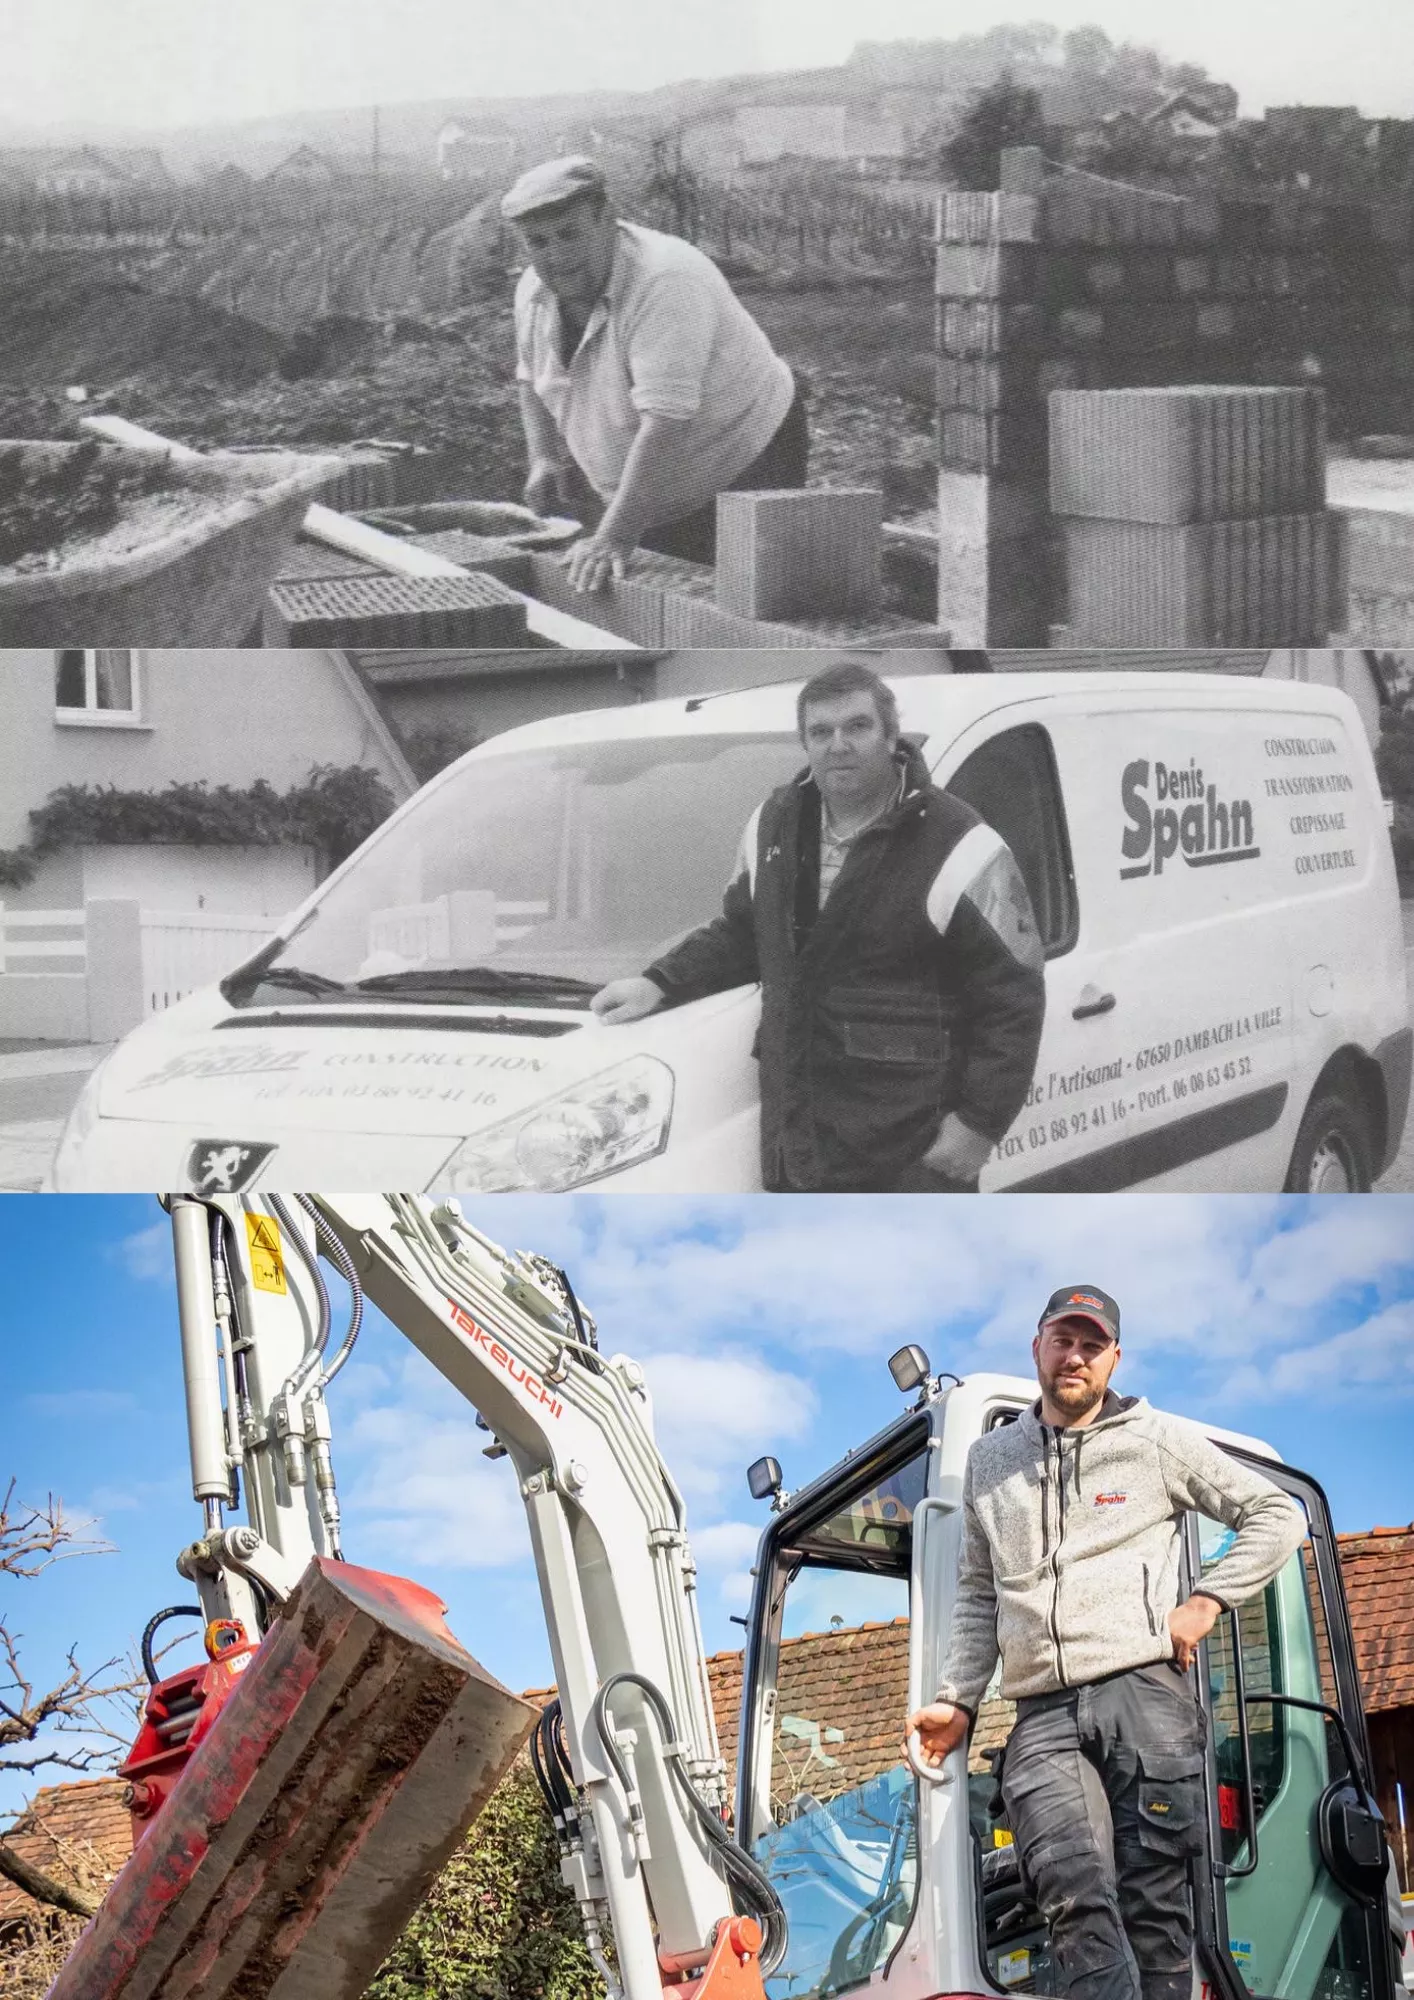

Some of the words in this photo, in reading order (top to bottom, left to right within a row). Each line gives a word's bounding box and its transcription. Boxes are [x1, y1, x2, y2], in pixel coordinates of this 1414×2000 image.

[1155, 757, 1205, 801] Denis
[1121, 758, 1254, 876] Spahn
[323, 1052, 549, 1073] CONSTRUCTION
[1049, 1057, 1123, 1100] l'Artisanat
[1136, 1042, 1171, 1071] 67650
[1174, 1022, 1233, 1059] DAMBACH
[1237, 1017, 1251, 1037] LA
[1254, 1006, 1281, 1030] VILLE
[472, 1090, 498, 1105] 16
[1029, 1126, 1047, 1149] 03
[1071, 1111, 1088, 1135] 92
[1091, 1104, 1106, 1127] 41
[1138, 1083, 1171, 1112] Port.
[1173, 1077, 1188, 1100] 06
[1190, 1071, 1205, 1094] 08
[1207, 1067, 1221, 1088] 63
[447, 1297, 563, 1420] TAKEUCHI
[1095, 1492, 1127, 1507] Spahn
